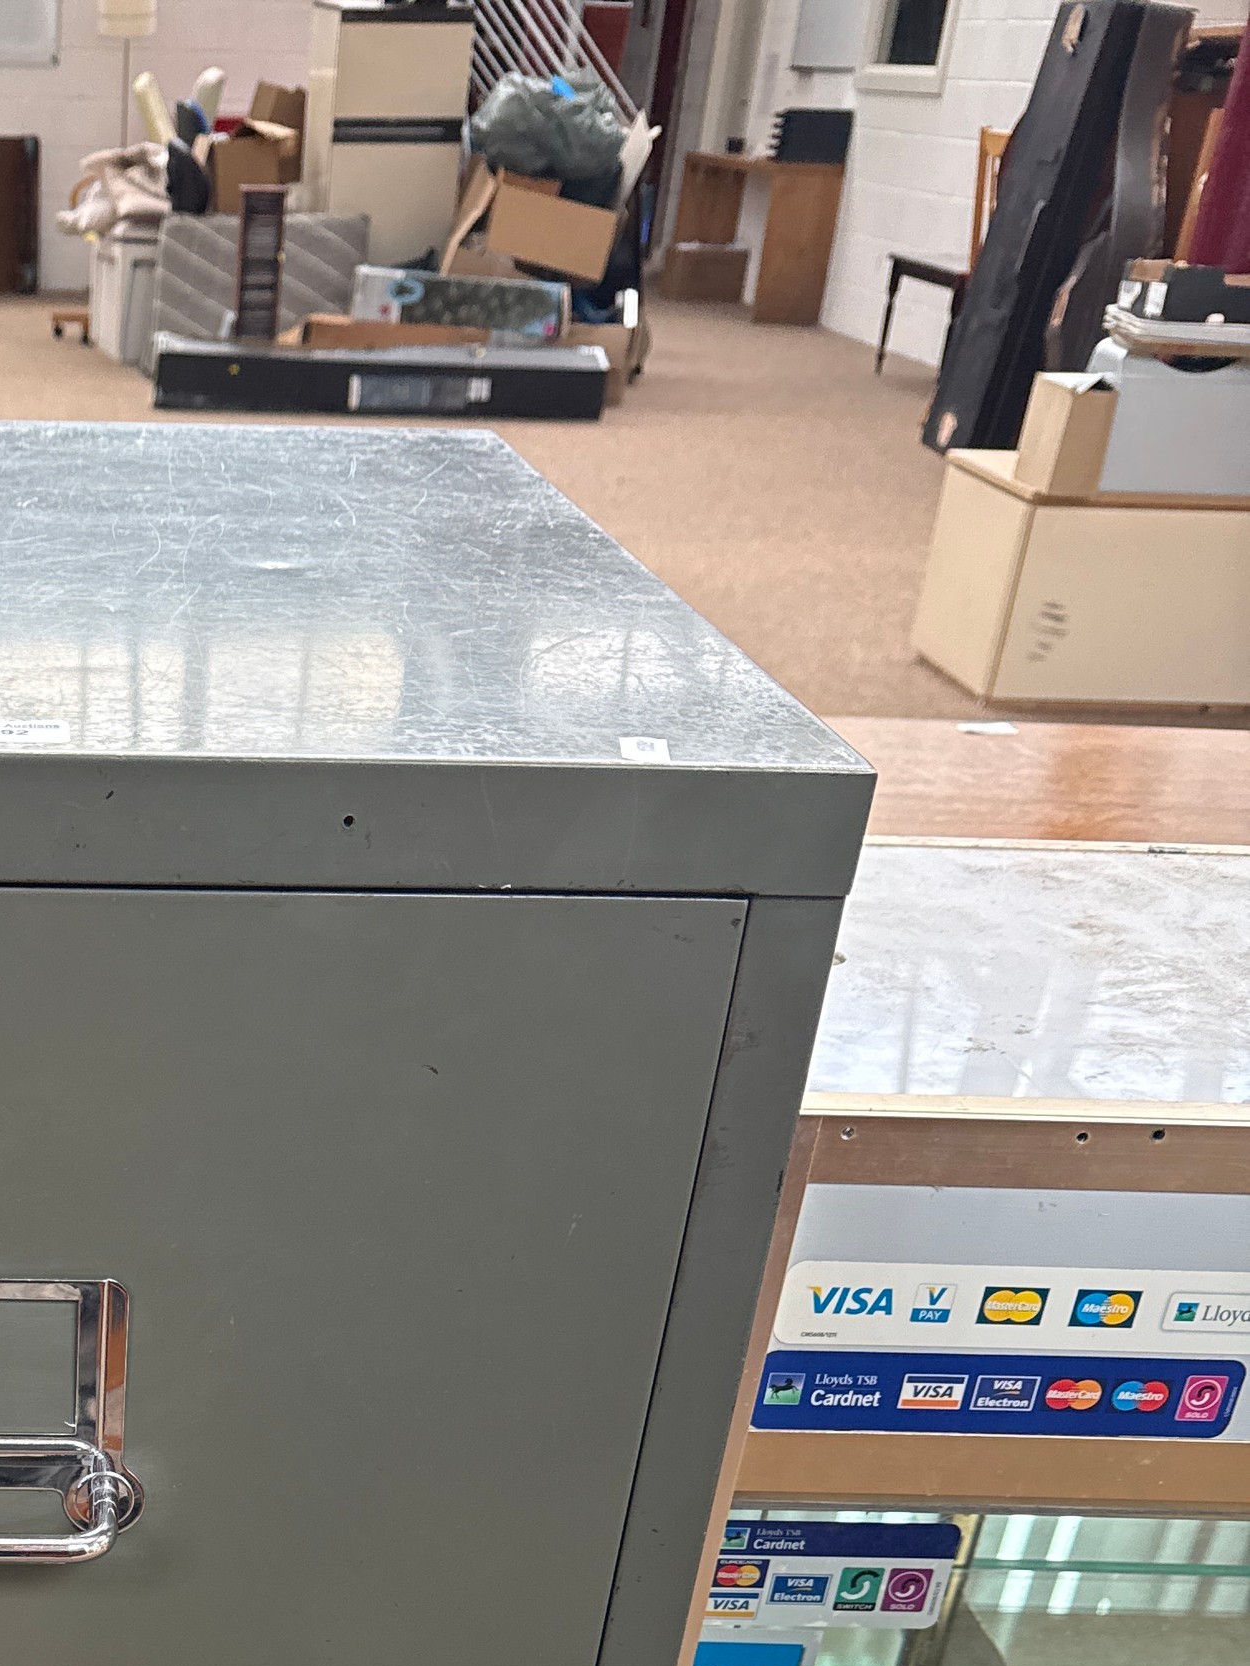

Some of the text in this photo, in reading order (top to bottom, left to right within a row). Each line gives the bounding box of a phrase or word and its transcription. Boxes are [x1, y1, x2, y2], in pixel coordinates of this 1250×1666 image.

[807, 1286, 893, 1315] VISA
[926, 1287, 948, 1306] V
[986, 1301, 1039, 1313] MasterCard
[1081, 1303, 1129, 1315] Maestro
[918, 1310, 943, 1320] PAY
[814, 1374, 878, 1388] Lloyds TSB
[992, 1380, 1023, 1390] VISA
[912, 1385, 955, 1398] VISA
[1046, 1390, 1101, 1400] MasterCard
[1117, 1391, 1164, 1401] Maestro
[810, 1390, 882, 1407] Cardnet
[976, 1397, 1029, 1408] Electron
[756, 1528, 783, 1537] Lloyds
[753, 1538, 806, 1550] Cardnet
[787, 1578, 814, 1587] VISA
[773, 1593, 821, 1602] Electron
[712, 1600, 750, 1610] VISA
